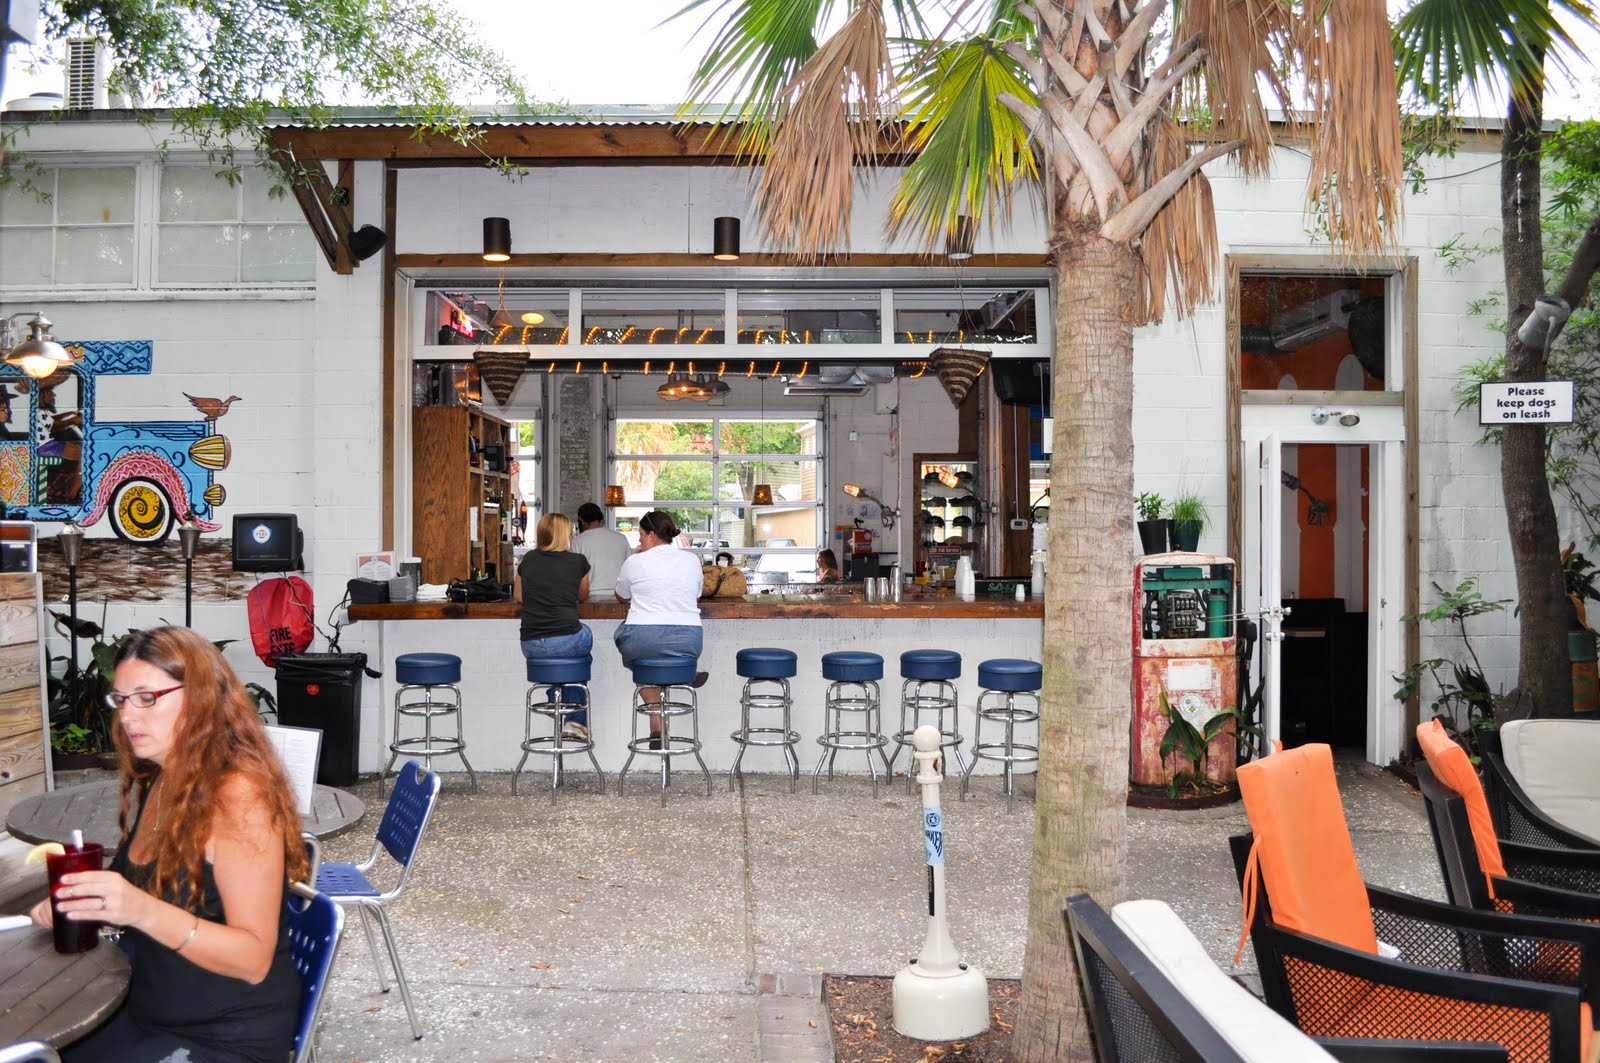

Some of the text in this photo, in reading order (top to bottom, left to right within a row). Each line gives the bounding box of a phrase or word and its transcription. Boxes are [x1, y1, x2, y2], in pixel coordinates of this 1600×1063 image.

[1507, 387, 1545, 396] Please
[1496, 398, 1556, 409] keep dogs
[1502, 409, 1551, 419] on leash
[269, 627, 292, 642] FIRE
